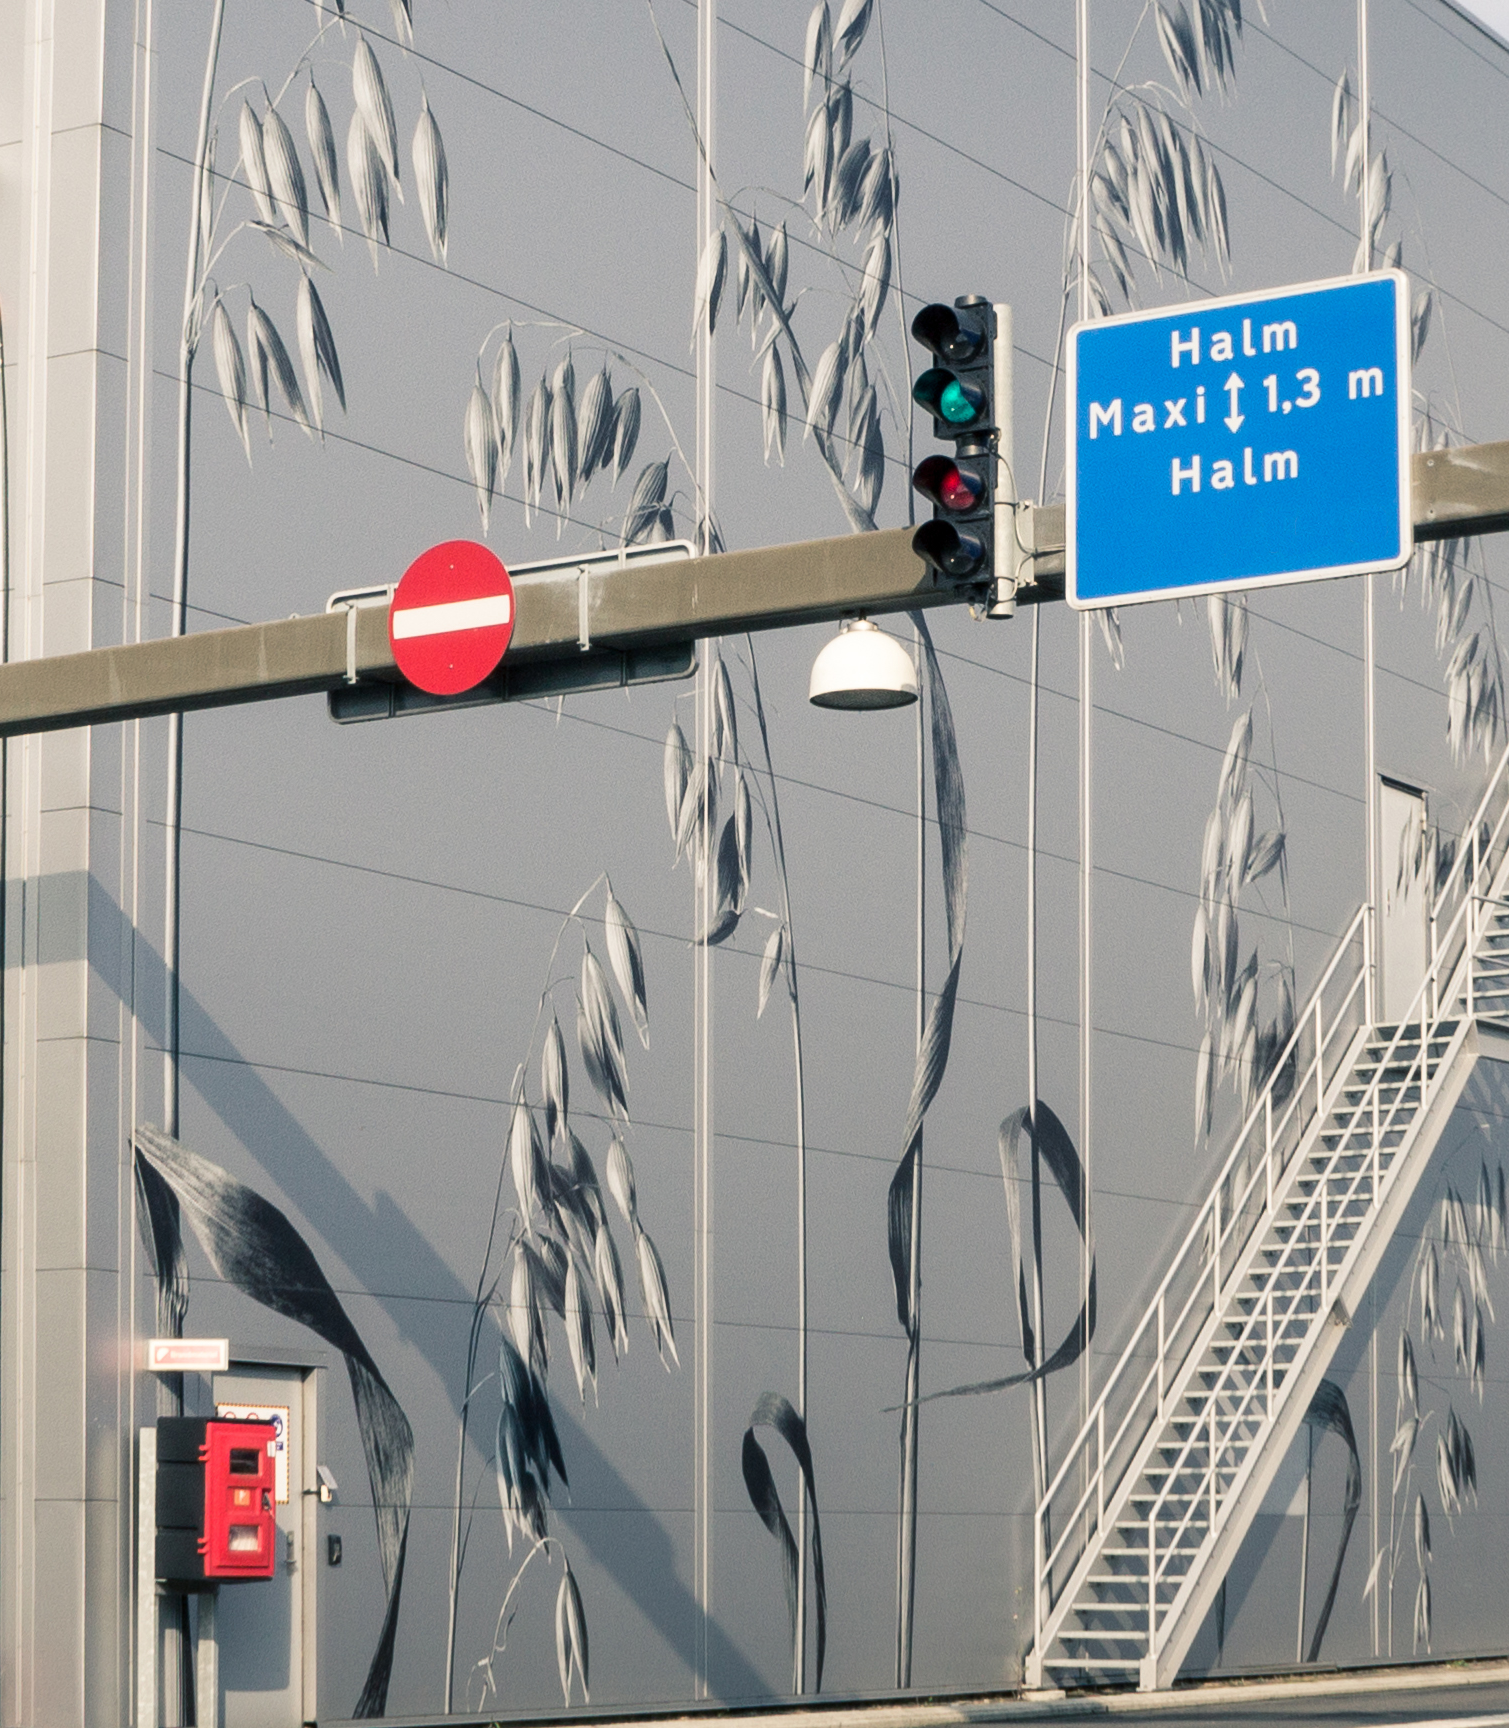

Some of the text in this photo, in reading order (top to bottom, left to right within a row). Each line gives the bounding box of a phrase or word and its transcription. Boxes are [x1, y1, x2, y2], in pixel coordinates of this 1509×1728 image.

[1170, 318, 1298, 369] Halm
[1089, 367, 1384, 440] Maxi 1,3 m
[1171, 446, 1299, 496] Halm
